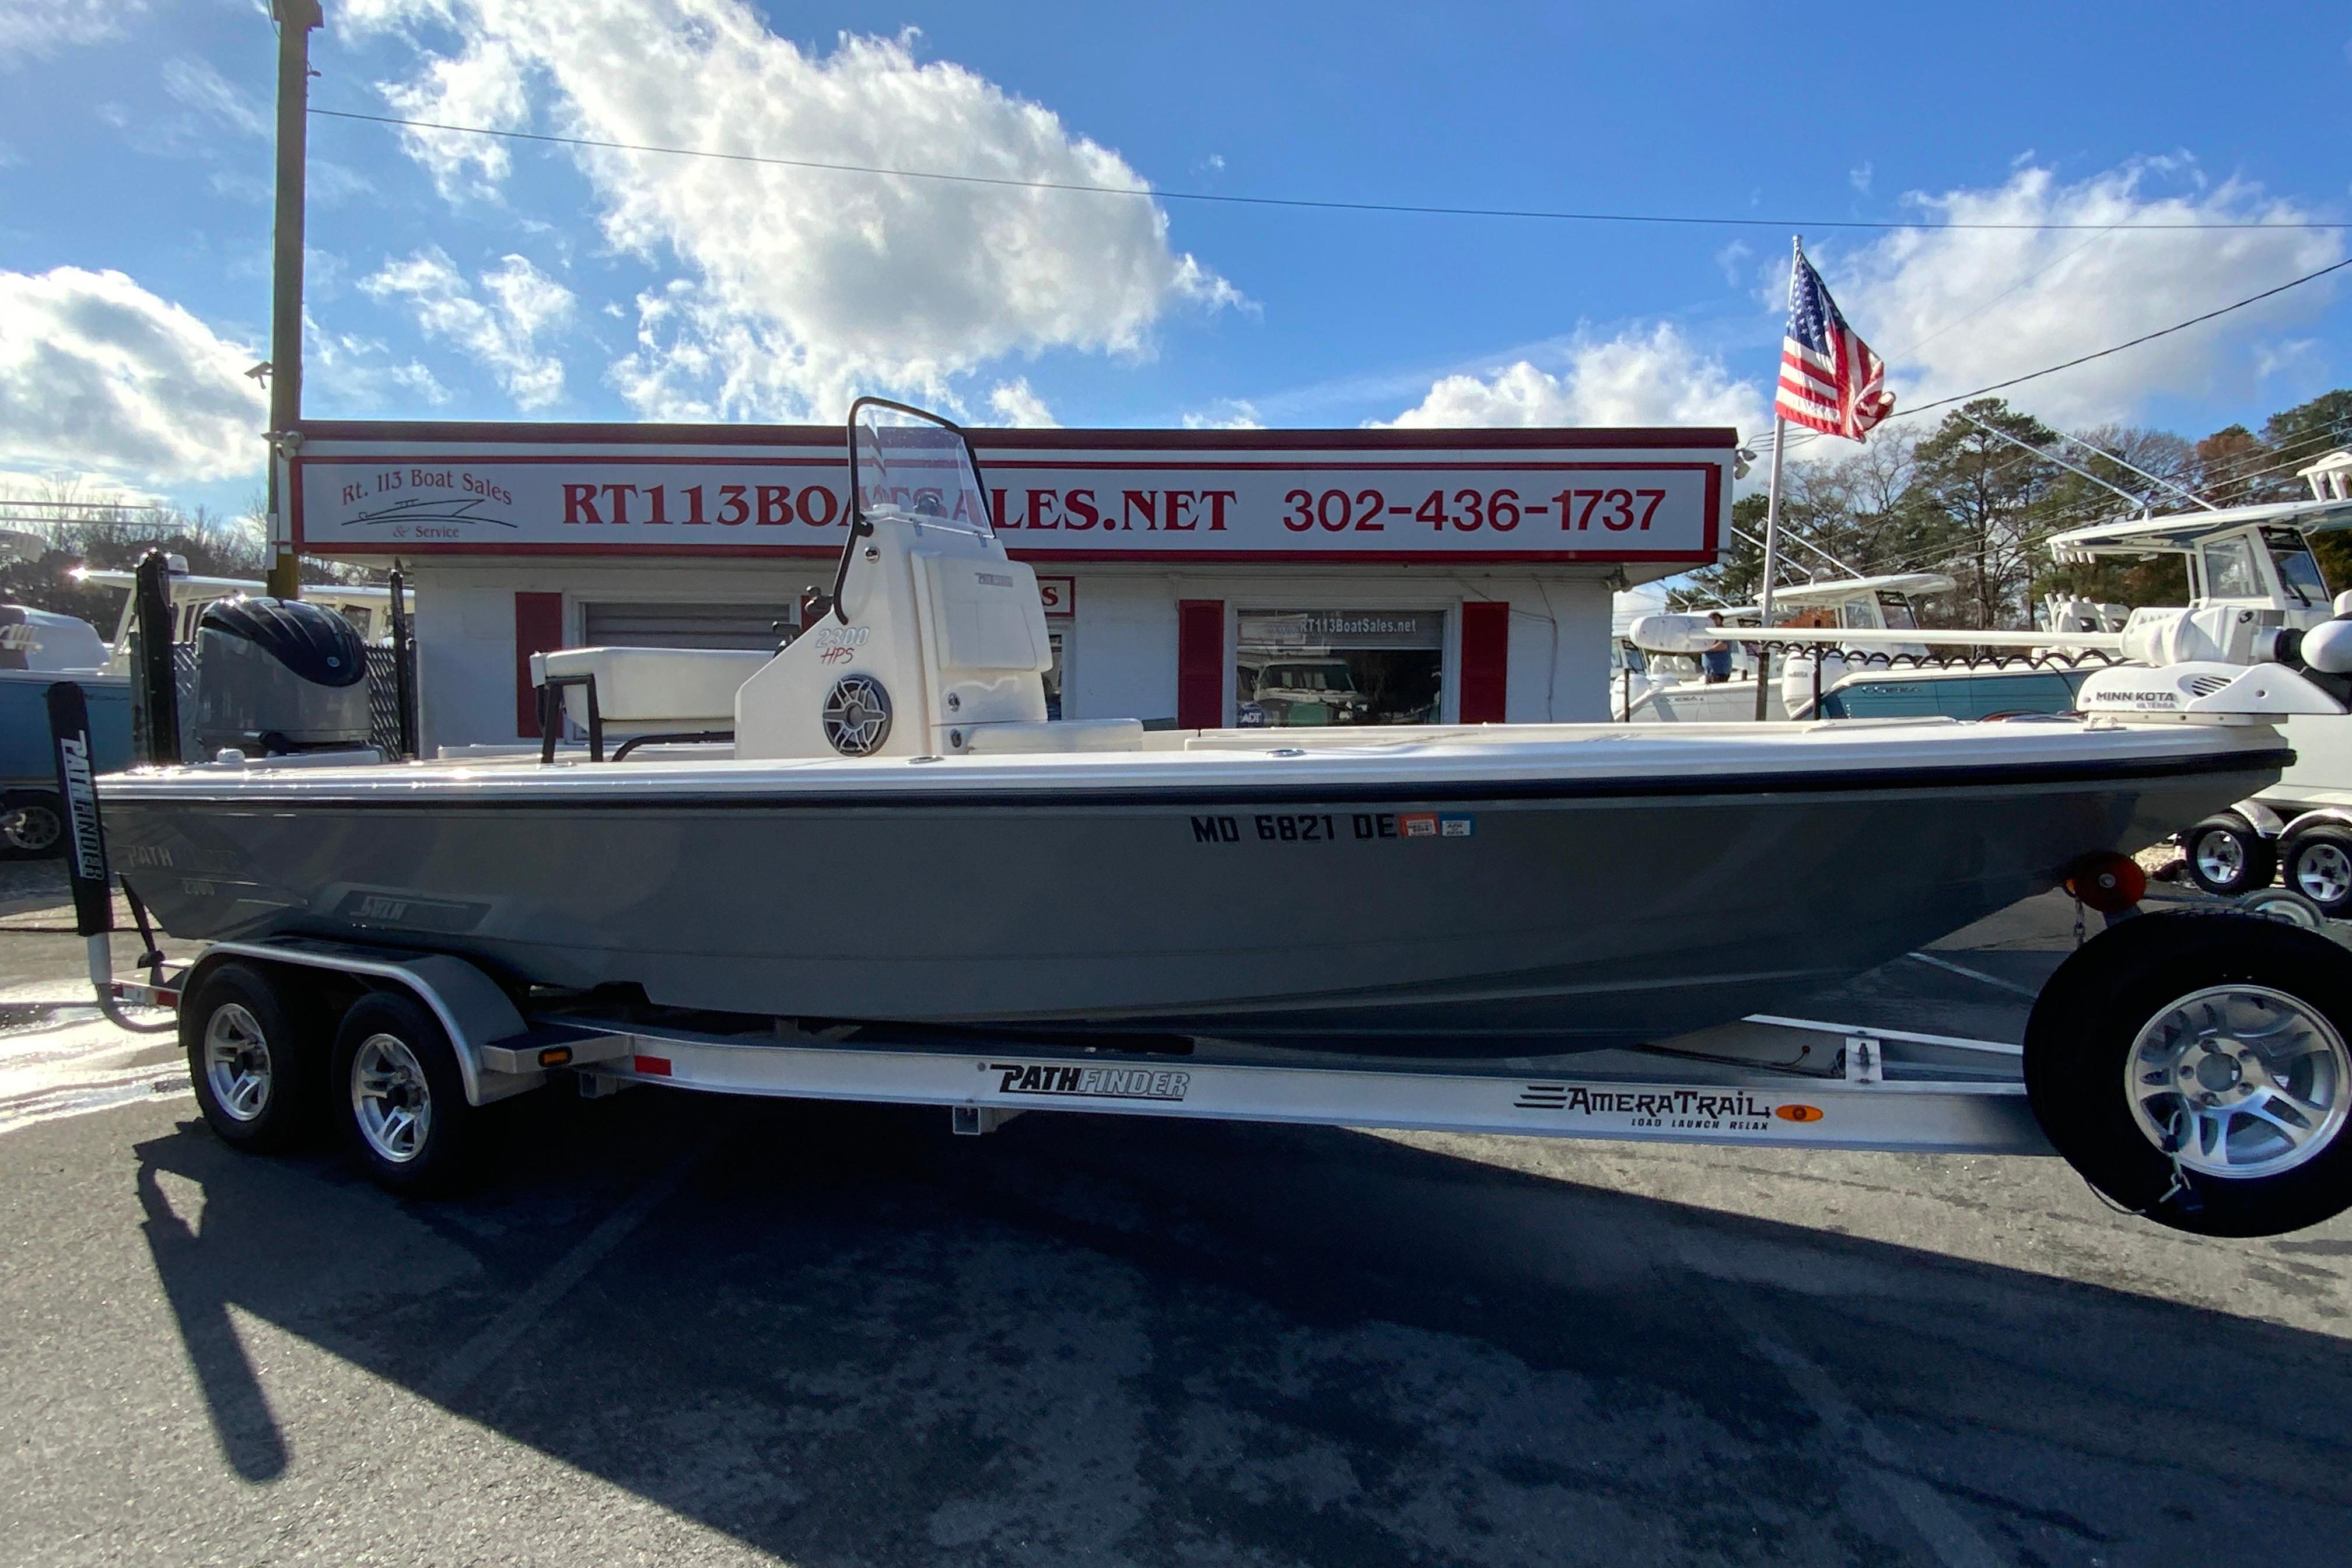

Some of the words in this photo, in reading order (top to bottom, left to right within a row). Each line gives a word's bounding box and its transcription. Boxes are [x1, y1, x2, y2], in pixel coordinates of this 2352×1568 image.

[342, 482, 369, 506] Rt.
[377, 470, 402, 492] 113
[411, 469, 453, 488] Boat
[463, 473, 512, 505] Sales
[1283, 488, 1666, 532] 302-436-1737
[415, 526, 459, 538] Service
[816, 626, 870, 648] 2300
[821, 647, 855, 665] HPS
[2096, 691, 2133, 701] MINN
[2135, 692, 2176, 702] KOTA
[1241, 712, 1261, 723] ADT
[60, 729, 106, 881] PATHFINDER
[1191, 816, 1240, 842] MD
[1255, 815, 1335, 841] 6821
[990, 1063, 1191, 1101] PATHFINDER
[1631, 1118, 1662, 1128] LOAD
[1671, 1119, 1720, 1129] LAUNCH
[1730, 1121, 1769, 1130] RELAX
